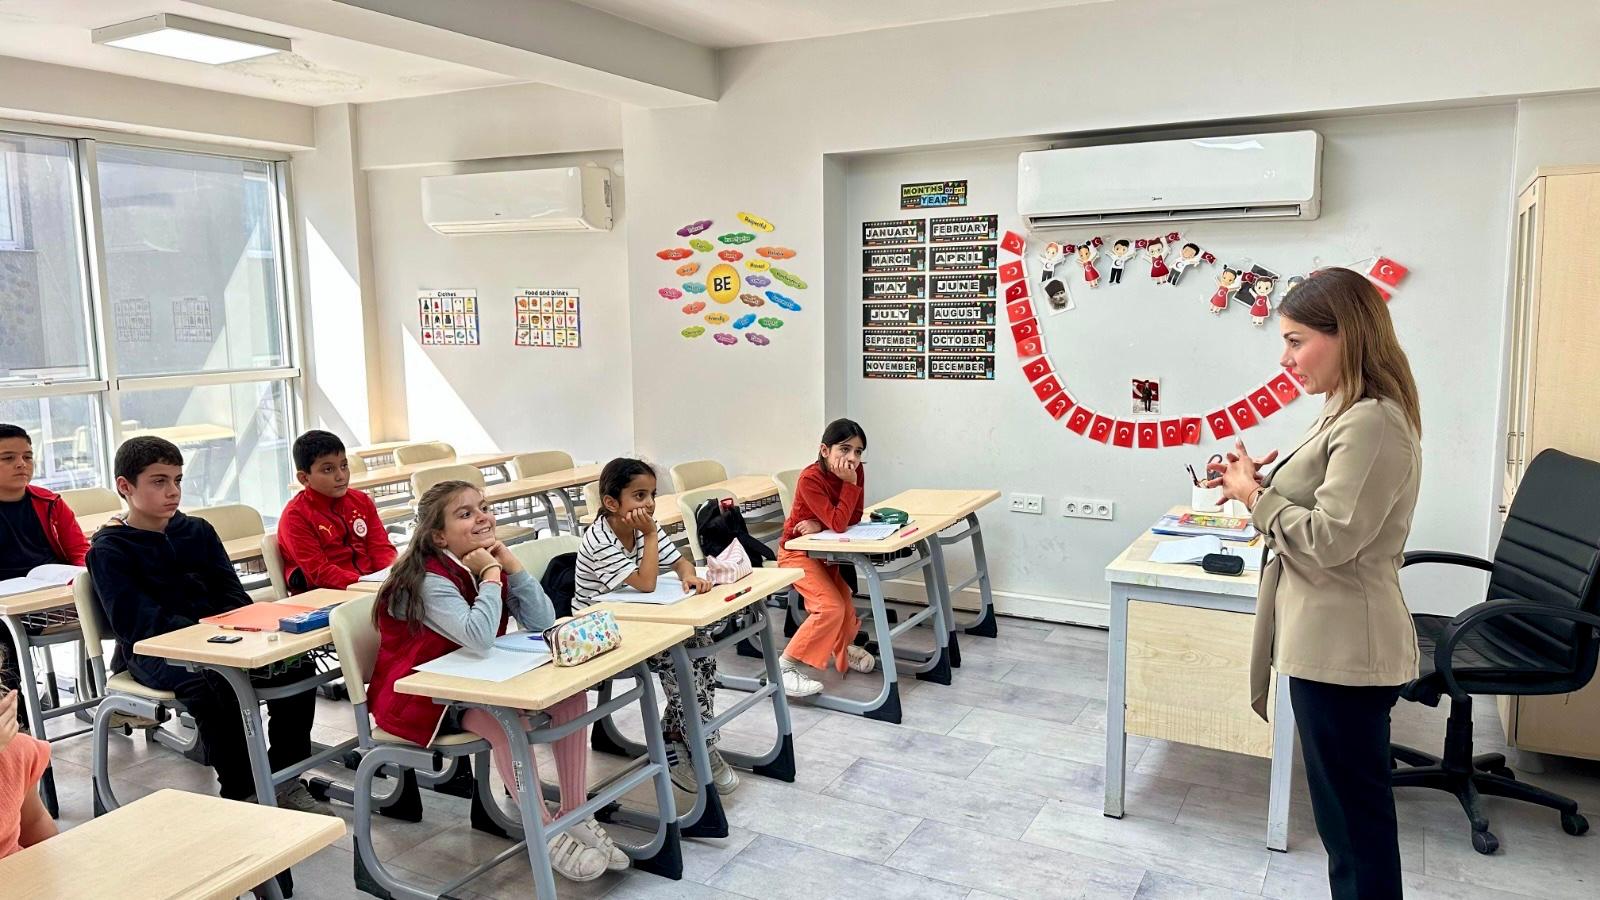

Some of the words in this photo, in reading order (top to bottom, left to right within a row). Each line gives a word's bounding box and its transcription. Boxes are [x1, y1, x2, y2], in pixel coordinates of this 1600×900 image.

[903, 184, 943, 196] MONTHS
[921, 195, 948, 206] YEAR
[866, 227, 917, 238] JANUARY
[933, 222, 988, 235] FEBRUARY
[872, 255, 911, 265] MARCH
[935, 252, 983, 264] APRIL
[713, 276, 732, 292] BE
[874, 282, 907, 293] MAY
[938, 280, 980, 291] JUNE
[871, 310, 910, 320] JULY
[934, 308, 982, 319] AUGUST
[865, 335, 917, 345] SEPTEMBER
[932, 335, 986, 345] OCTOBER
[865, 361, 917, 371] NOVEMBER
[932, 361, 986, 371] DECEMBER
